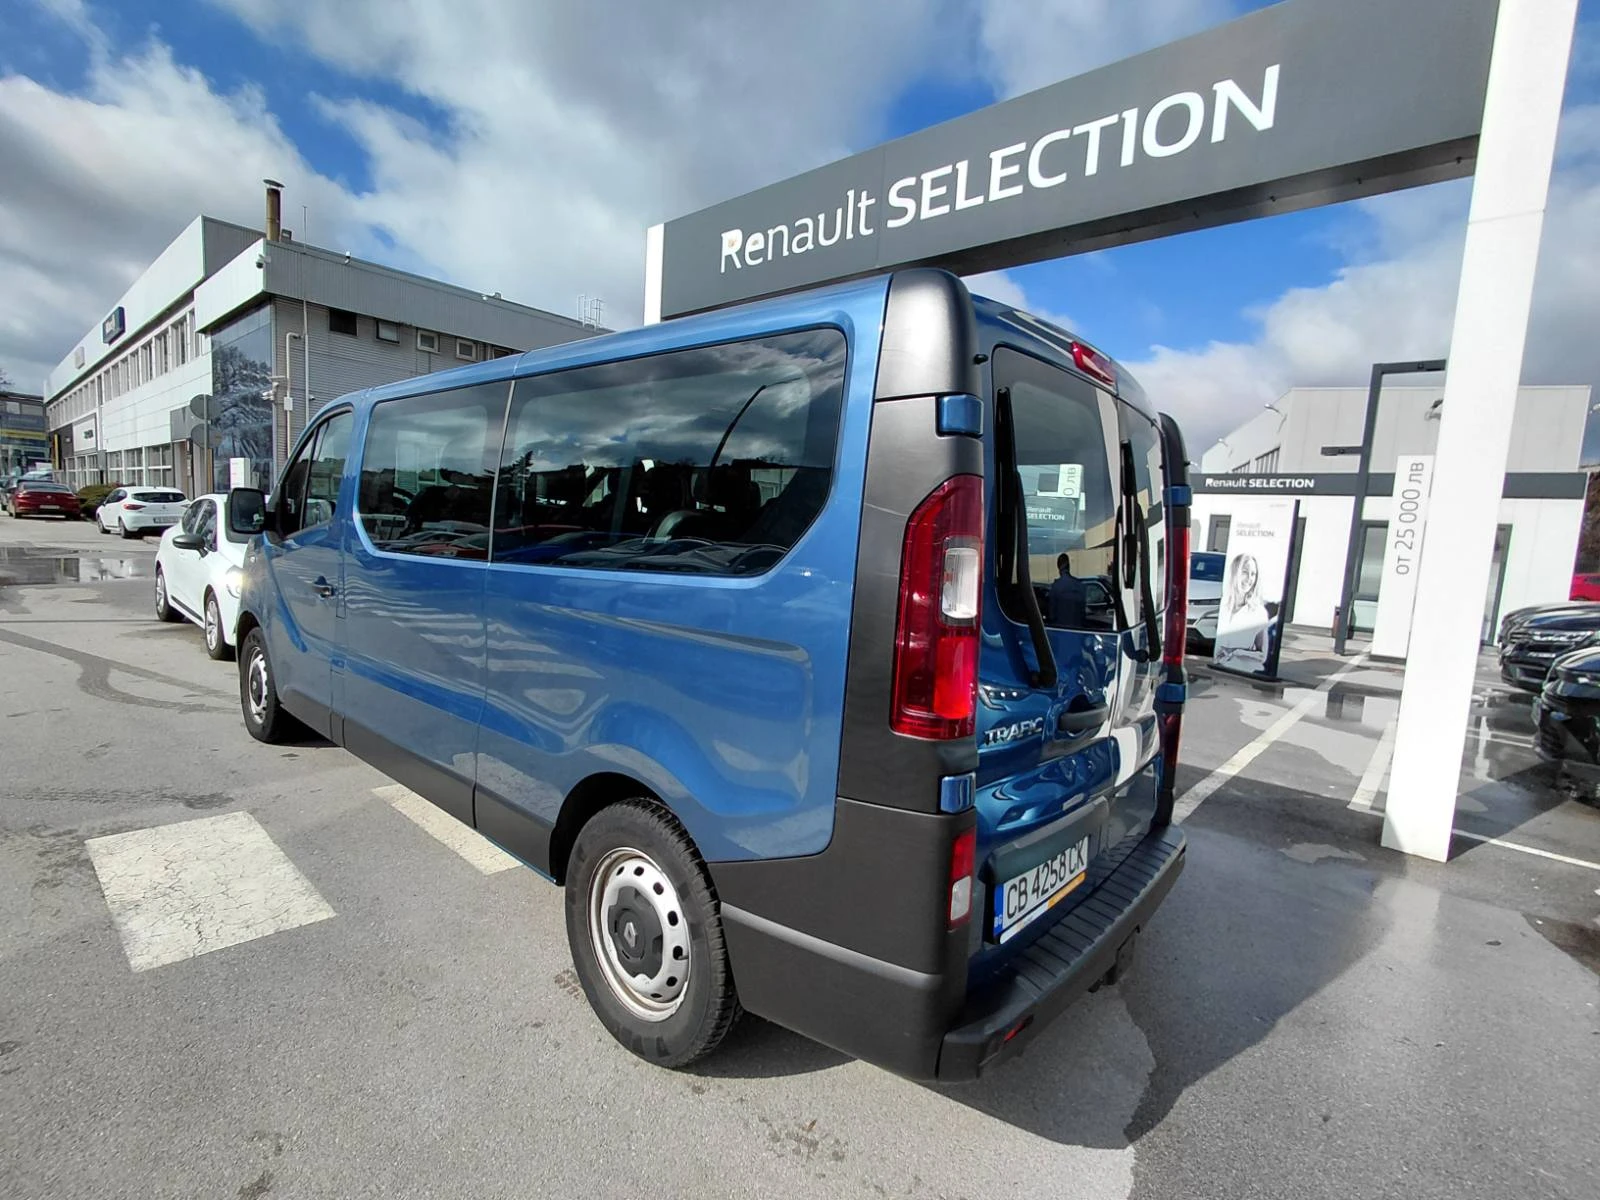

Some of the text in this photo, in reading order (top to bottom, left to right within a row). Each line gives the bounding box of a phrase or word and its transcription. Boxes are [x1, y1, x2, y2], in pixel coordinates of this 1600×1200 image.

[720, 62, 1281, 274] Renault SELECTION
[1205, 478, 1315, 489] Renault SELECTION
[1235, 529, 1275, 537] SELECTION
[1394, 461, 1425, 576] от 25 000 лв
[984, 716, 1044, 747] TRAFIC
[1006, 876, 1028, 920] CB
[1031, 850, 1067, 900] 4258
[1068, 838, 1086, 875] CK
